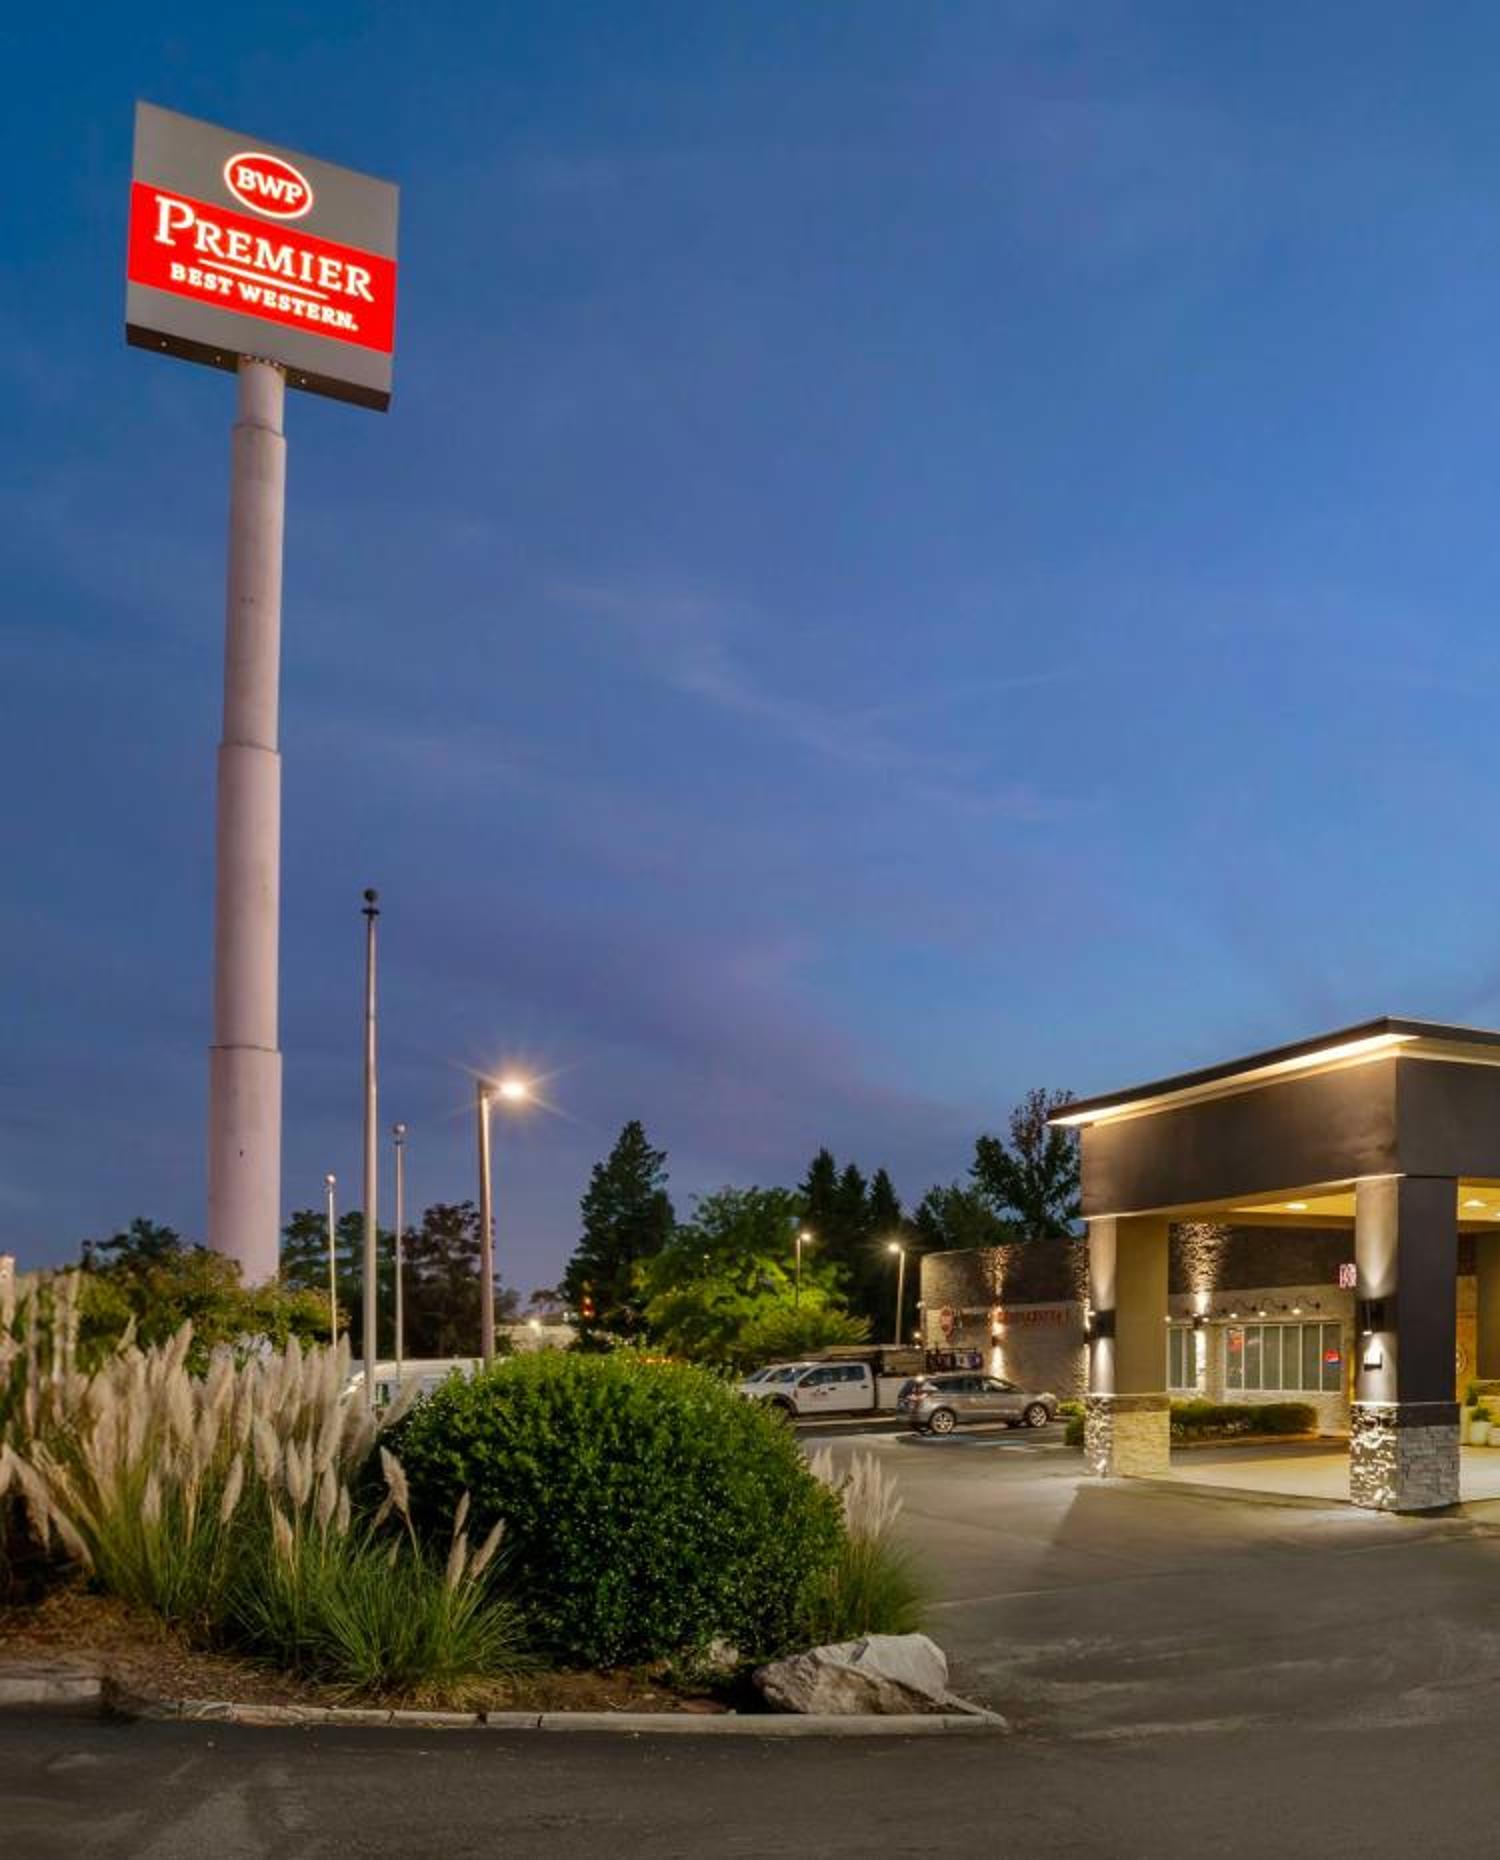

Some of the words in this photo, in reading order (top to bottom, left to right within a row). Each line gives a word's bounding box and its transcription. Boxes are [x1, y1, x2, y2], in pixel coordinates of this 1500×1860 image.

[236, 165, 304, 205] BWP
[153, 194, 375, 302] PREMIER
[169, 262, 234, 295] BEST
